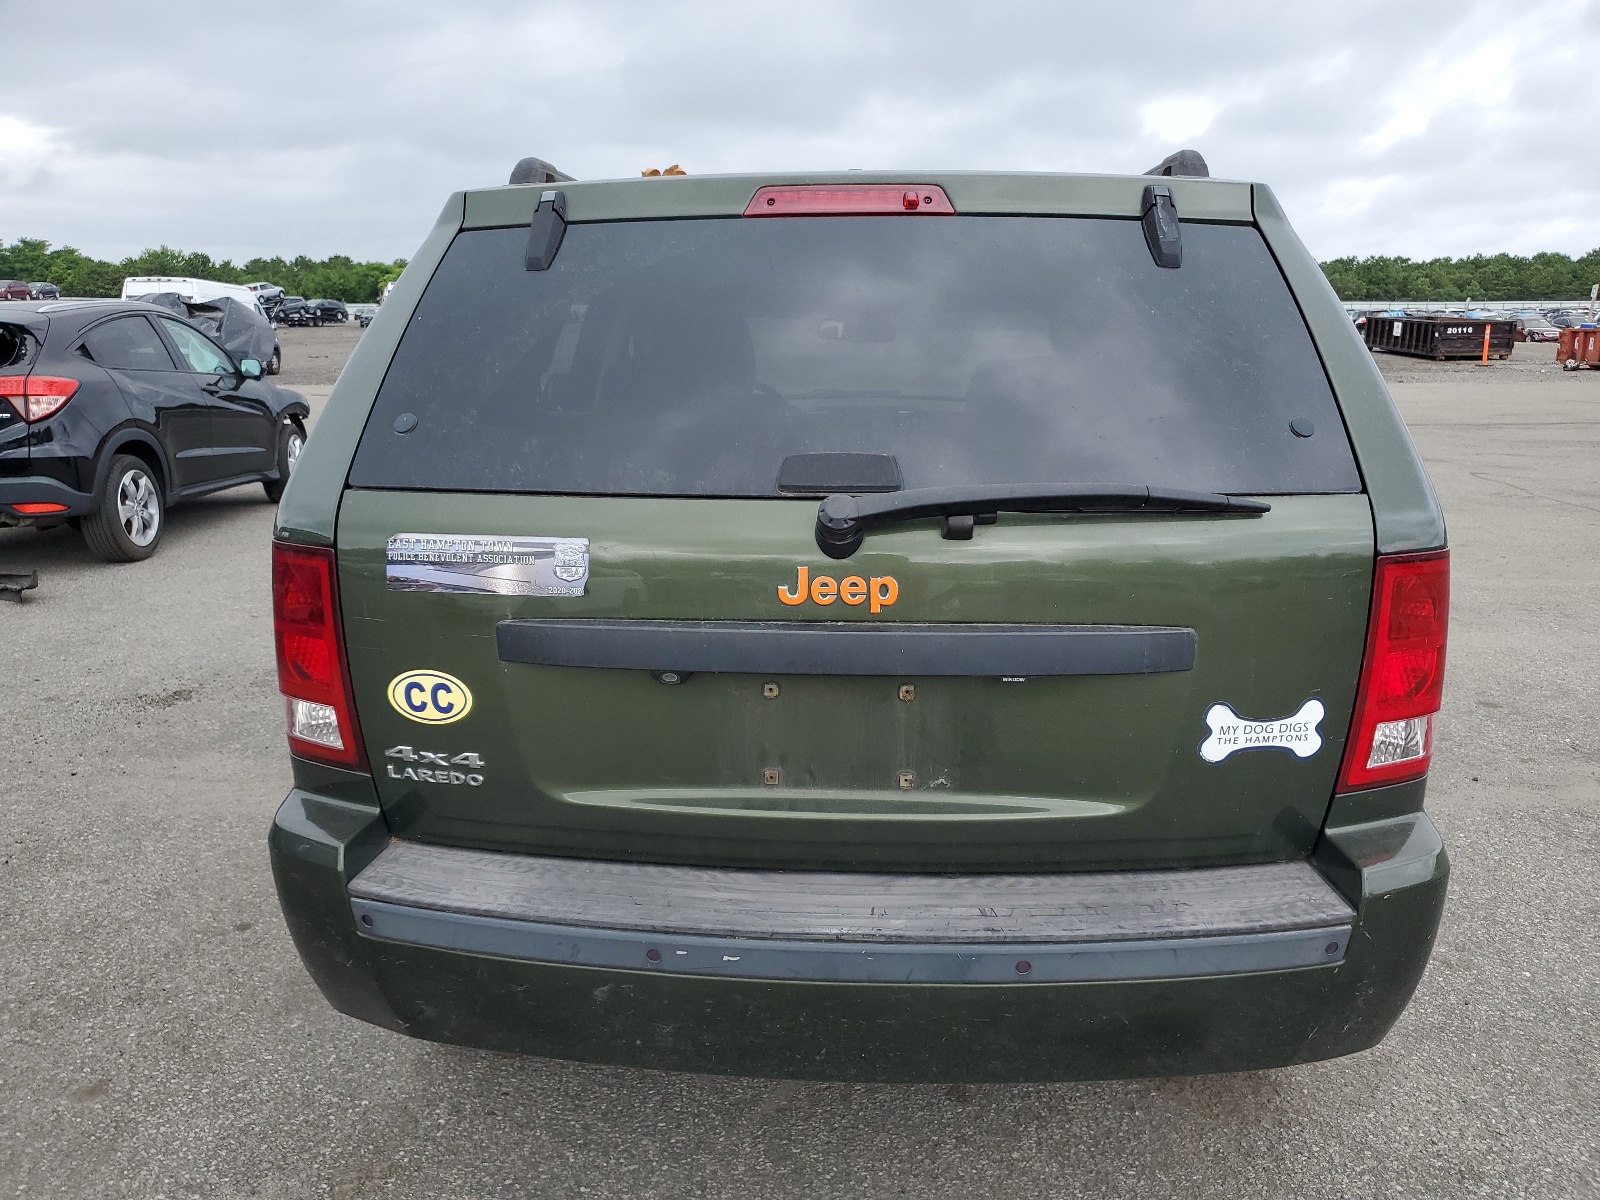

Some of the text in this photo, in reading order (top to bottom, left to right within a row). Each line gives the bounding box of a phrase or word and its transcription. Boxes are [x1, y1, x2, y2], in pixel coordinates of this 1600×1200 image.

[1446, 326, 1473, 334] 20116
[387, 538, 514, 553] EAST HAMPTON TOWN
[387, 552, 535, 565] POLICE BENEVOLENT ASSOCIATION
[777, 566, 899, 614] Jeep
[404, 681, 455, 714] CC
[1219, 722, 1309, 736] MY DOG DIGS
[1217, 733, 1309, 745] THE HAMPTONS
[386, 763, 485, 787] LAREDO
